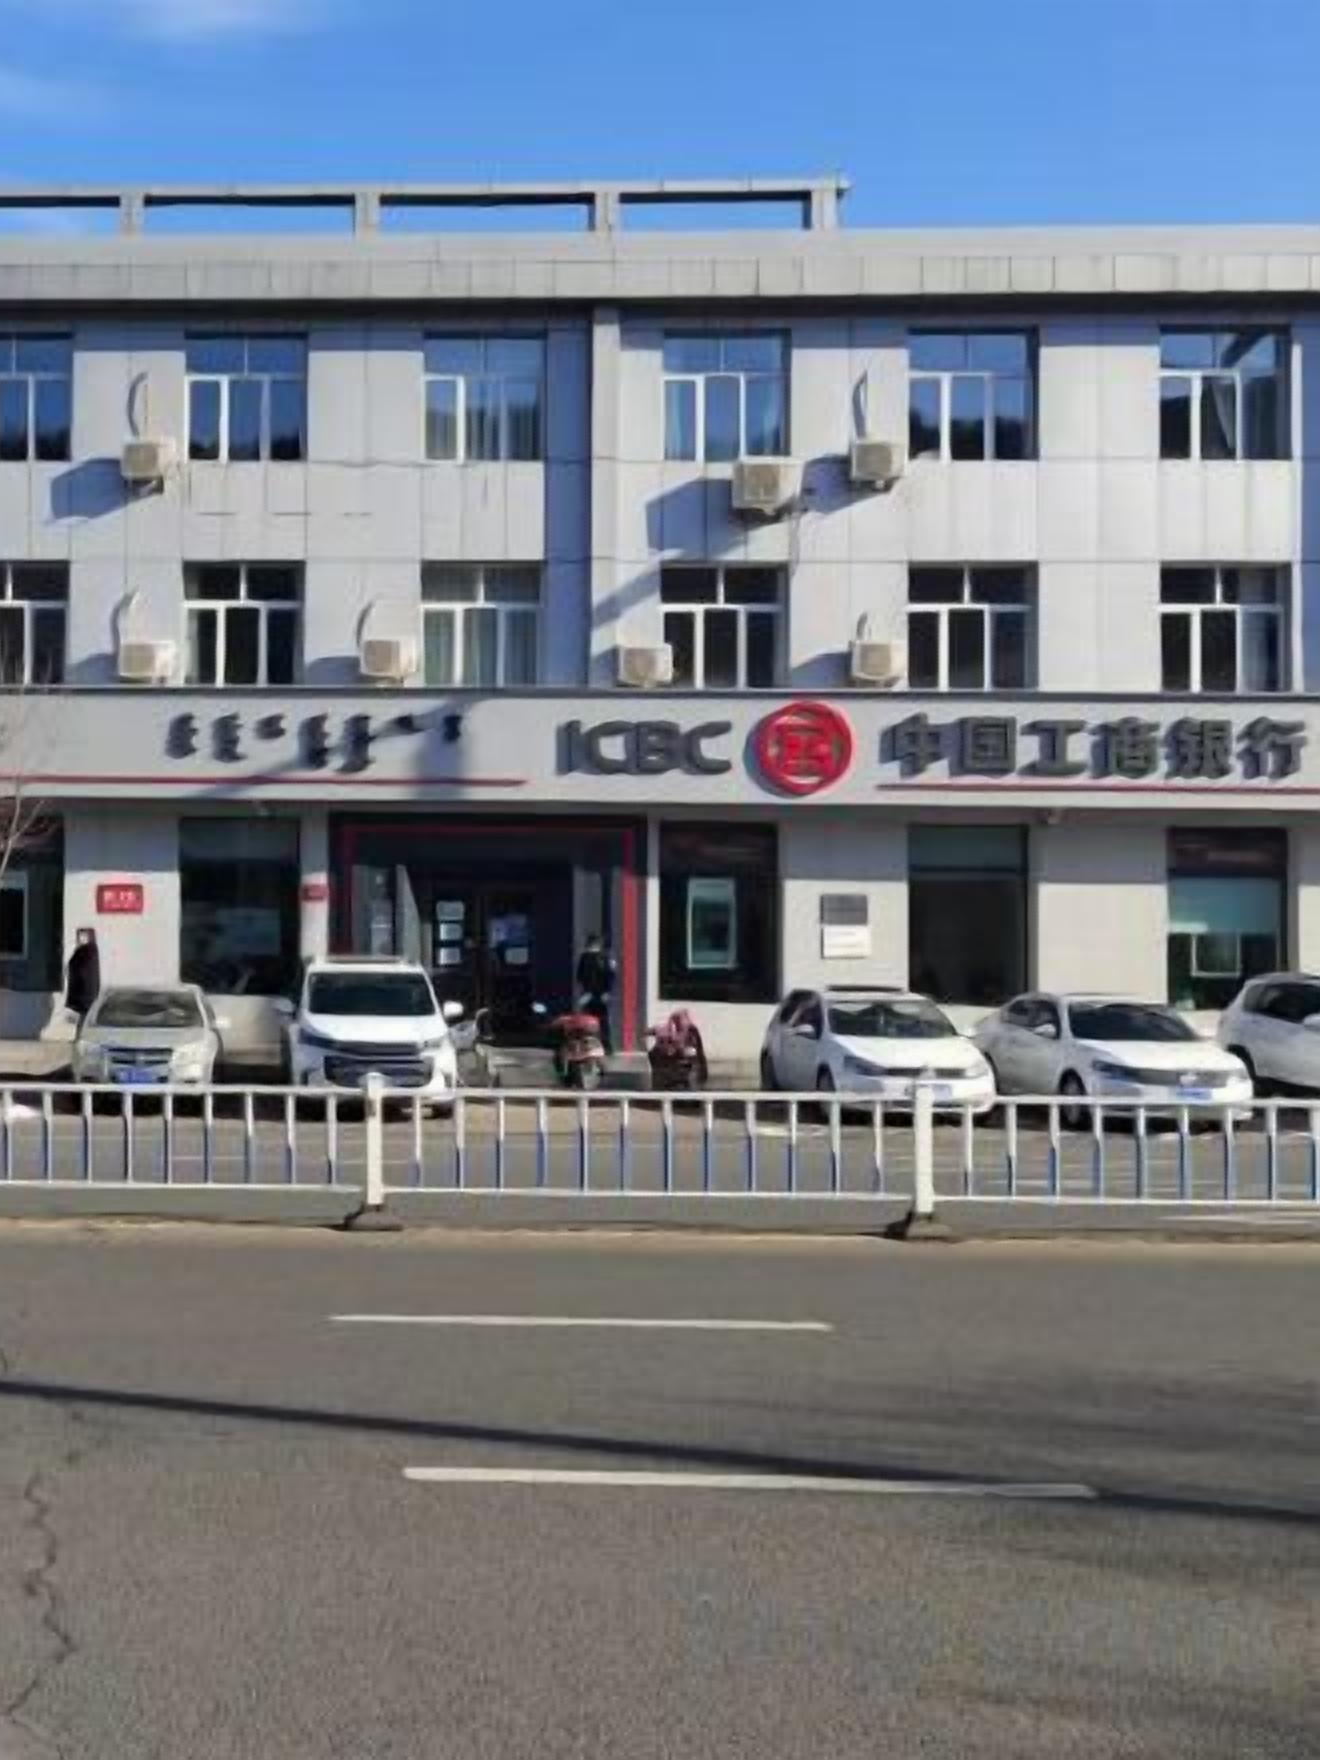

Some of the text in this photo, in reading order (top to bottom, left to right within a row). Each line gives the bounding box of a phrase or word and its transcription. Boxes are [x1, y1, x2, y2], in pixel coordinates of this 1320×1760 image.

[557, 720, 732, 775] ICBC
[881, 713, 1307, 779] 中国工商银行
